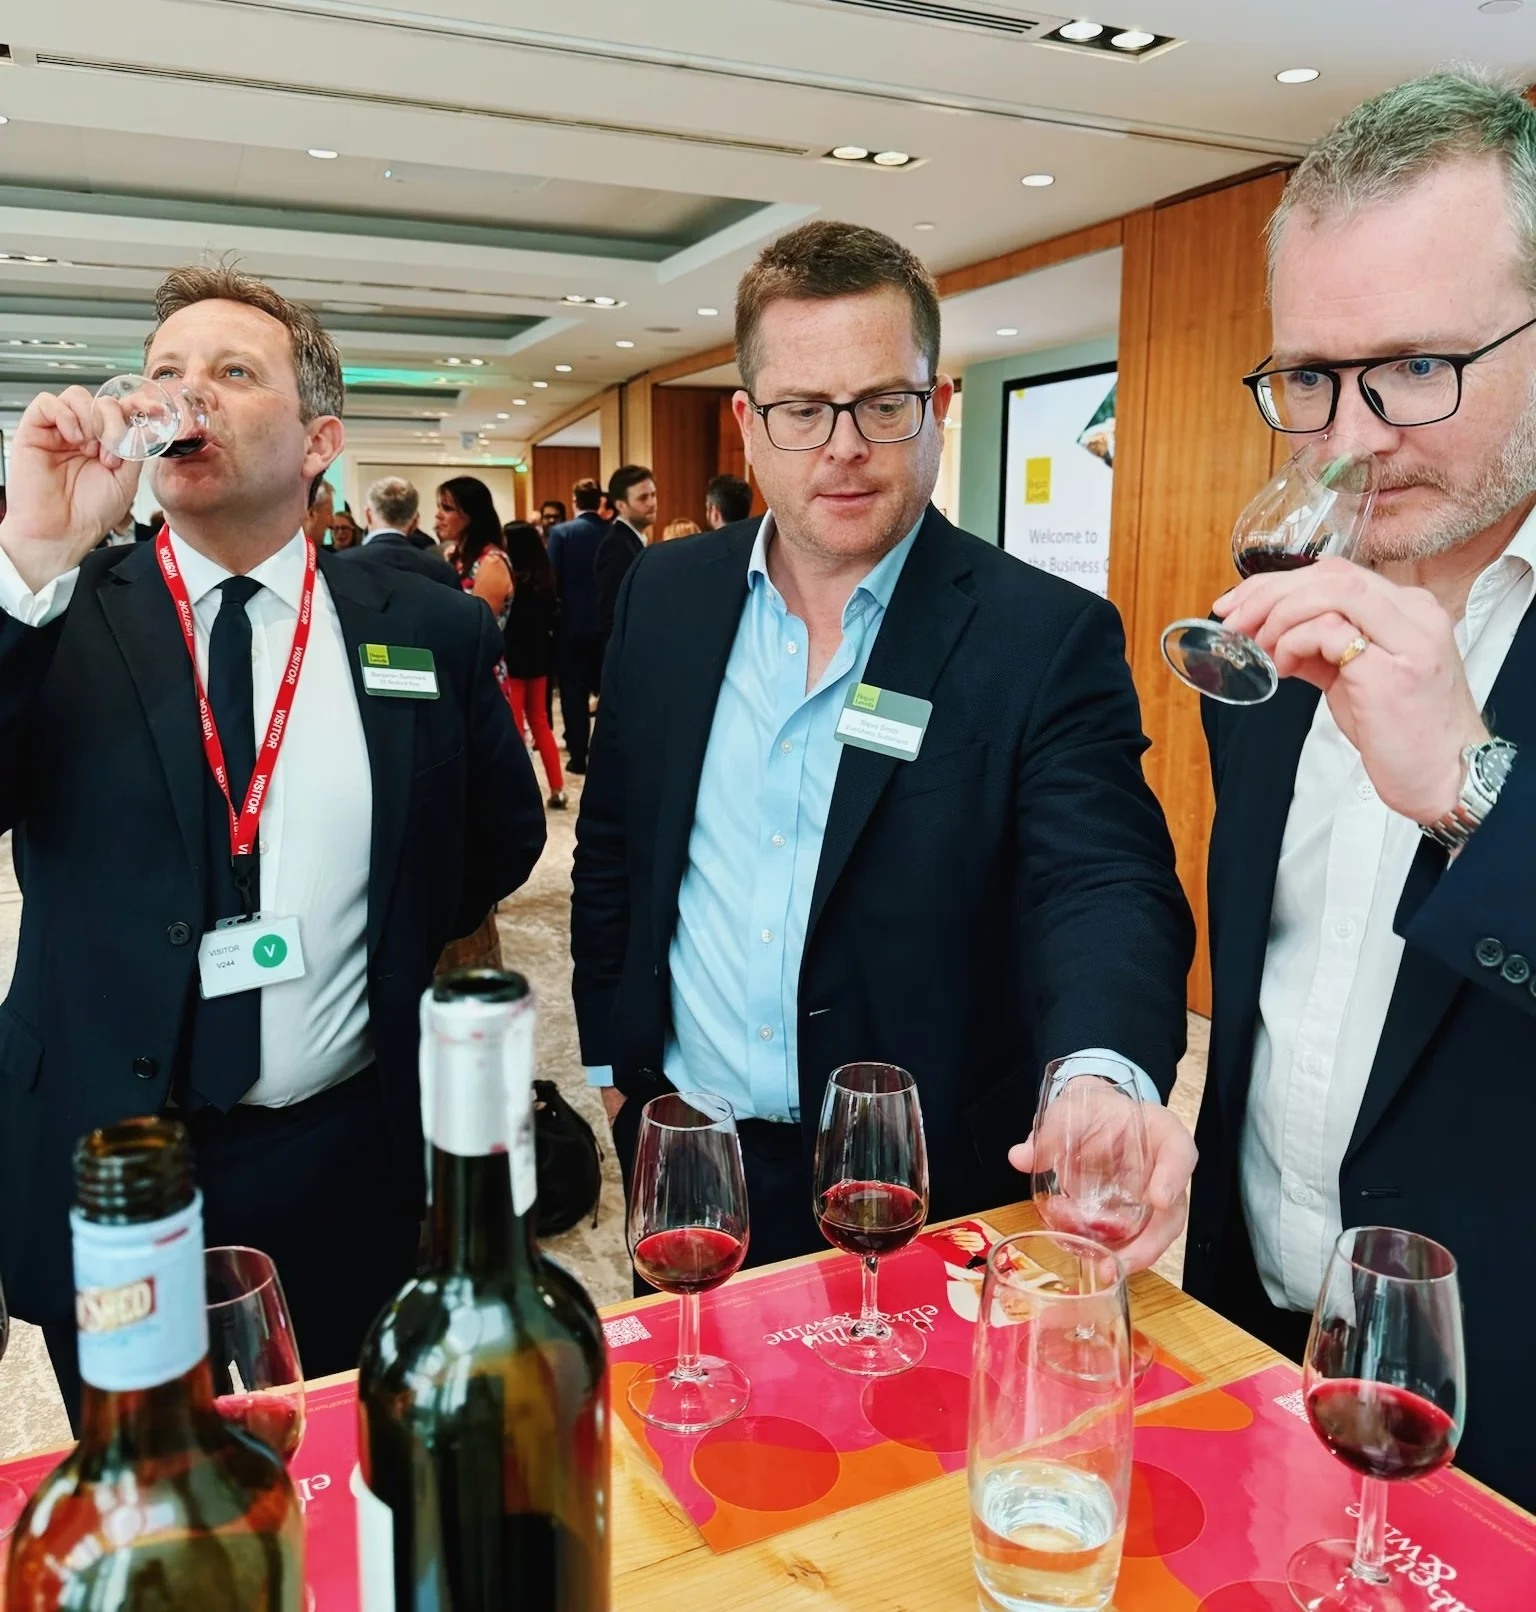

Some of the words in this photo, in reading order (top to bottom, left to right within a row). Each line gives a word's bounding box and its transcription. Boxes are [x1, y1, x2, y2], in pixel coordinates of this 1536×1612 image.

[1029, 529, 1083, 544] Welcome
[1085, 530, 1099, 544] to
[160, 545, 179, 580] VISITOR
[1049, 557, 1101, 573] Business
[178, 599, 194, 637] VISITOR
[301, 590, 312, 625] VISITOR
[285, 646, 304, 685] VISITOR
[200, 698, 214, 741] VISITOR
[266, 709, 287, 749] VISITOR
[245, 774, 268, 815] VISITOR
[208, 944, 241, 957] VISITOR
[216, 960, 236, 970] V244
[263, 943, 276, 958] V
